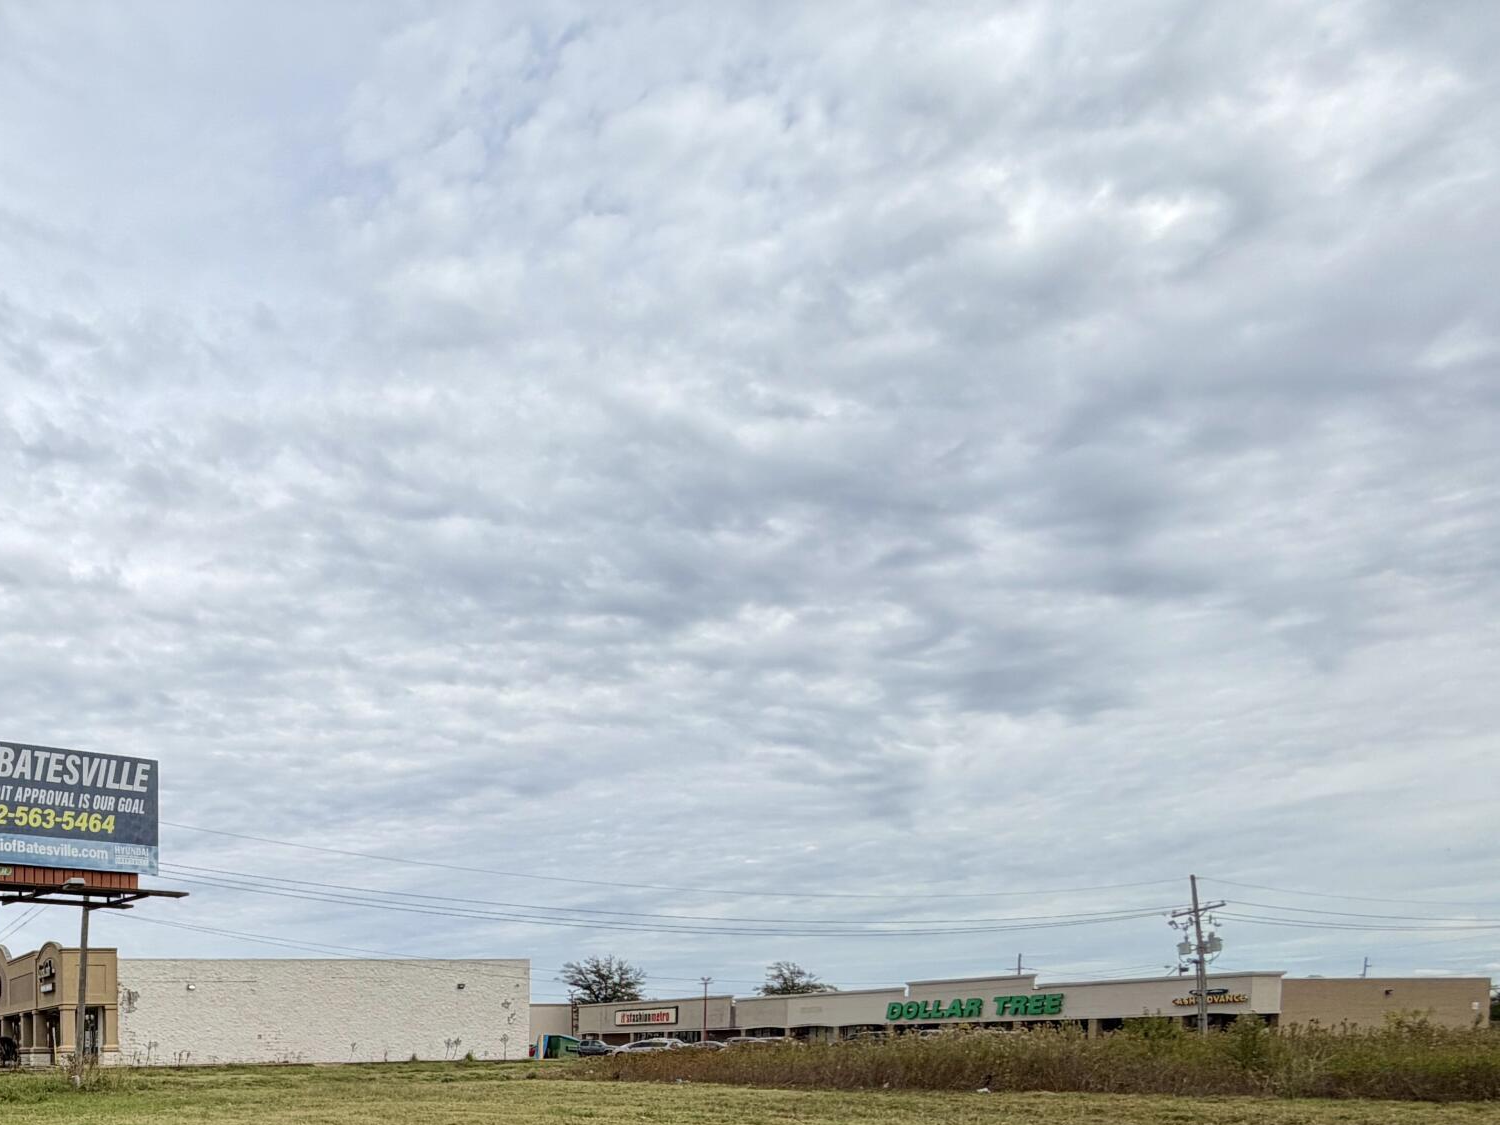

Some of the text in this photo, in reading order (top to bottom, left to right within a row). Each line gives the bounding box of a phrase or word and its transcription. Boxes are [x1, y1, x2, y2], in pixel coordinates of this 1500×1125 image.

[14, 787, 75, 808] APPROVAL
[78, 793, 90, 809] IS
[92, 794, 115, 811] OUR
[117, 797, 145, 814] GOAL
[114, 845, 149, 857] HYUNDAI
[886, 993, 1064, 1021] DOLLAR TREE
[1201, 993, 1248, 1004] DVANCE
